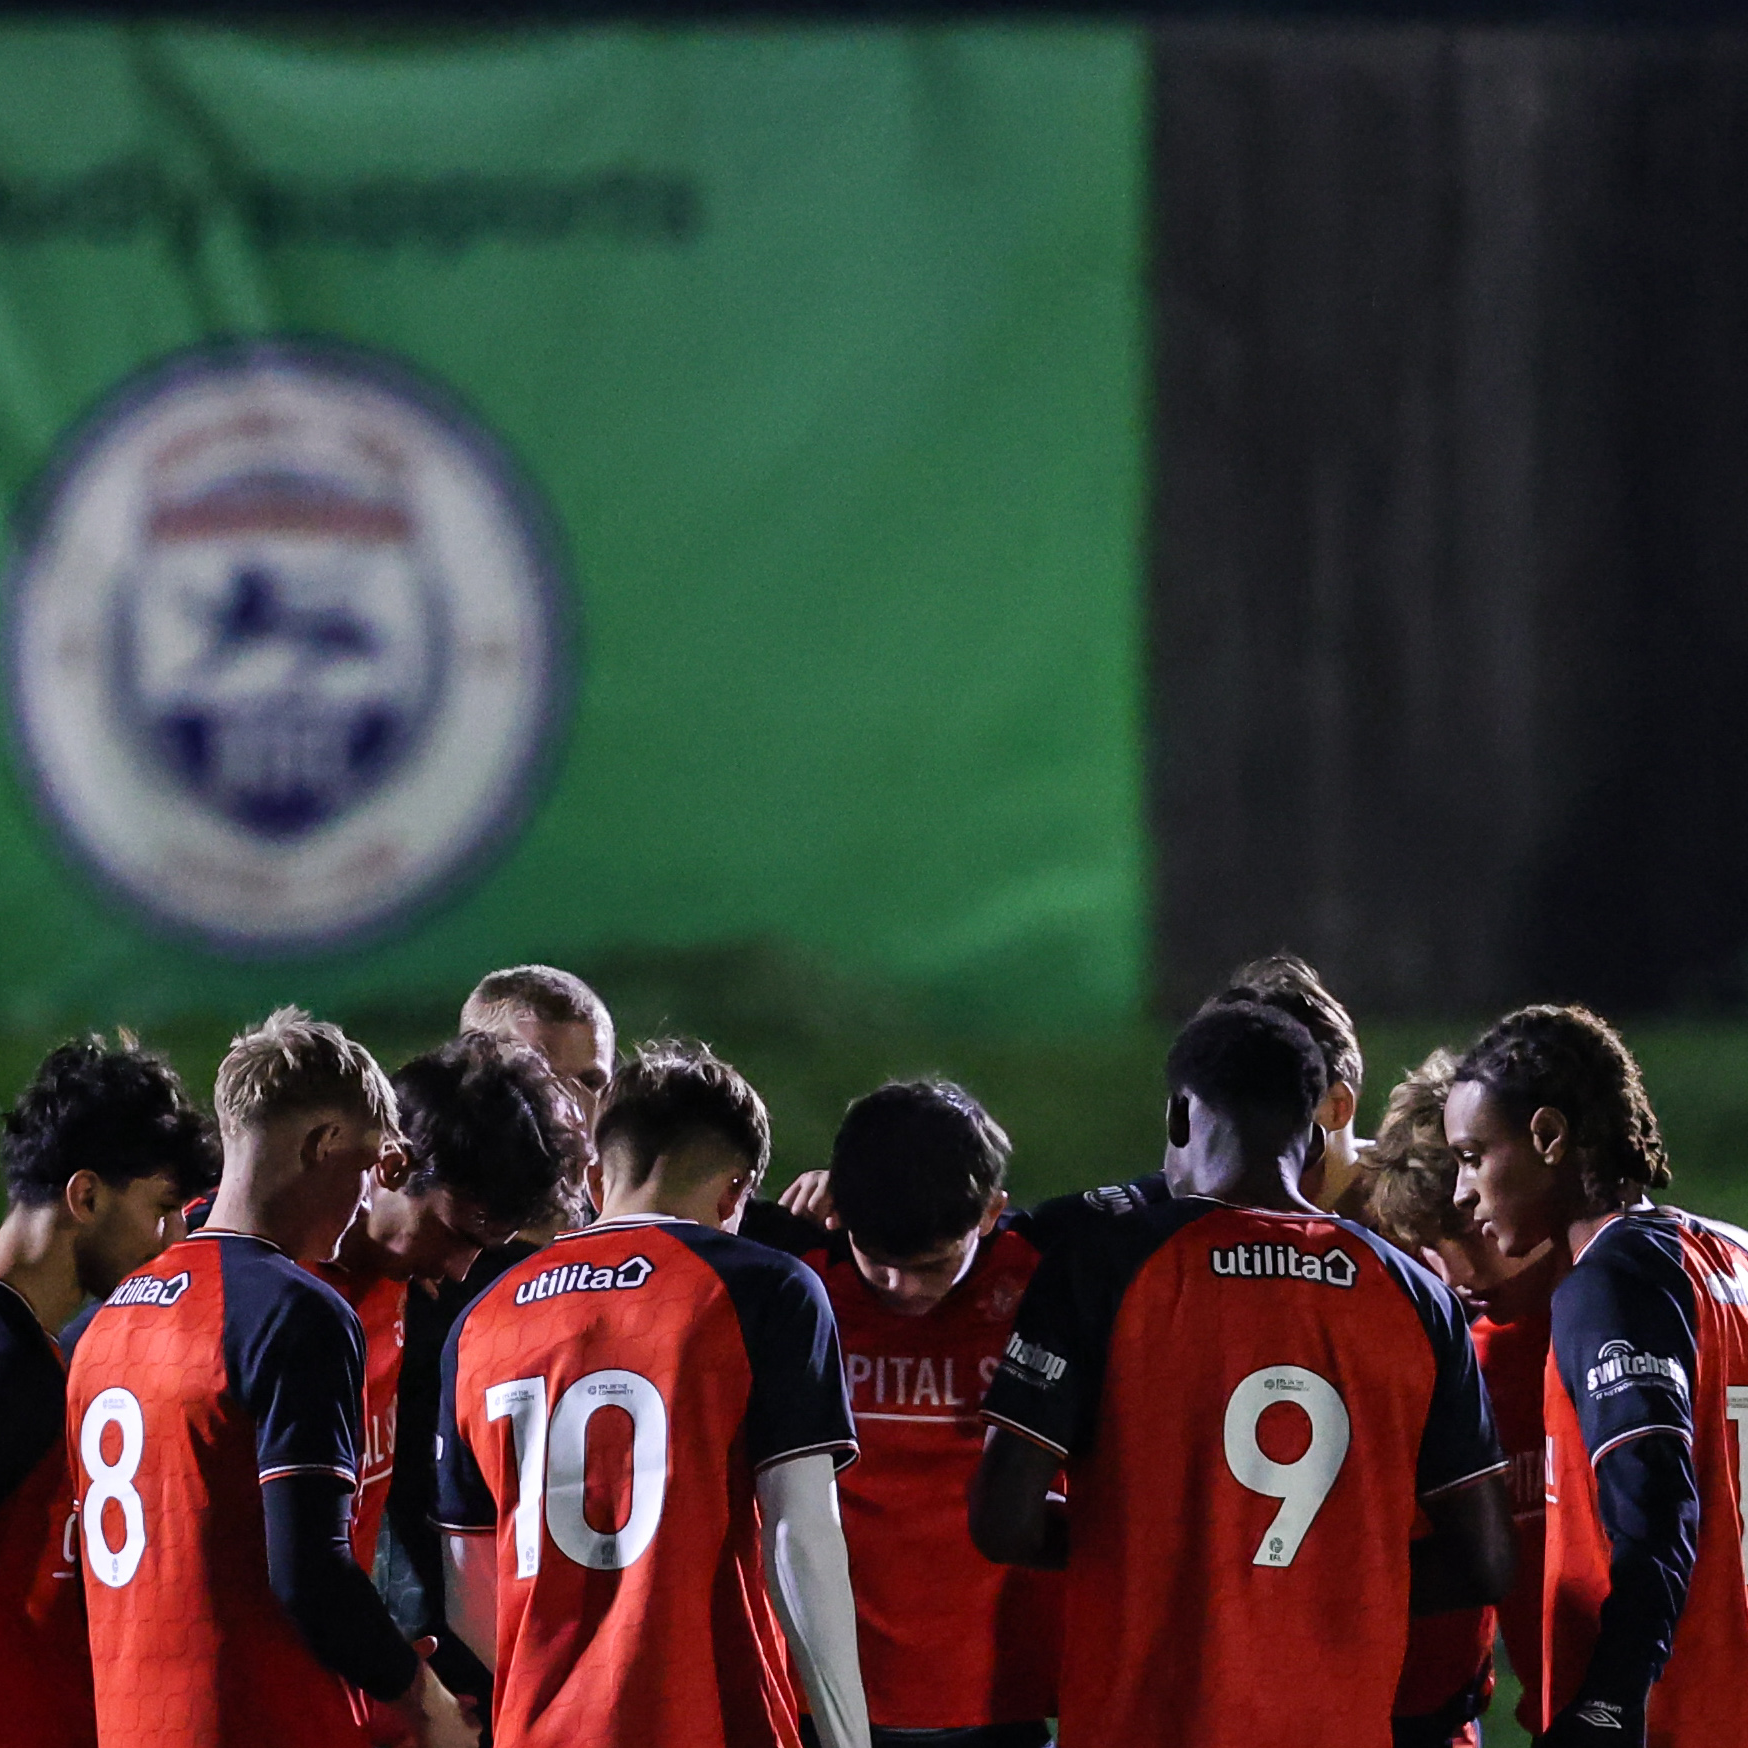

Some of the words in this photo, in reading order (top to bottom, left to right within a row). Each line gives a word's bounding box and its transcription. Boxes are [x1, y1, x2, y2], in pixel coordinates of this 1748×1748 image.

[516, 1263, 613, 1304] utilita
[1214, 1245, 1322, 1281] utilita
[80, 1387, 147, 1588] 8
[485, 1368, 668, 1579] 10
[1223, 1364, 1350, 1567] 9
